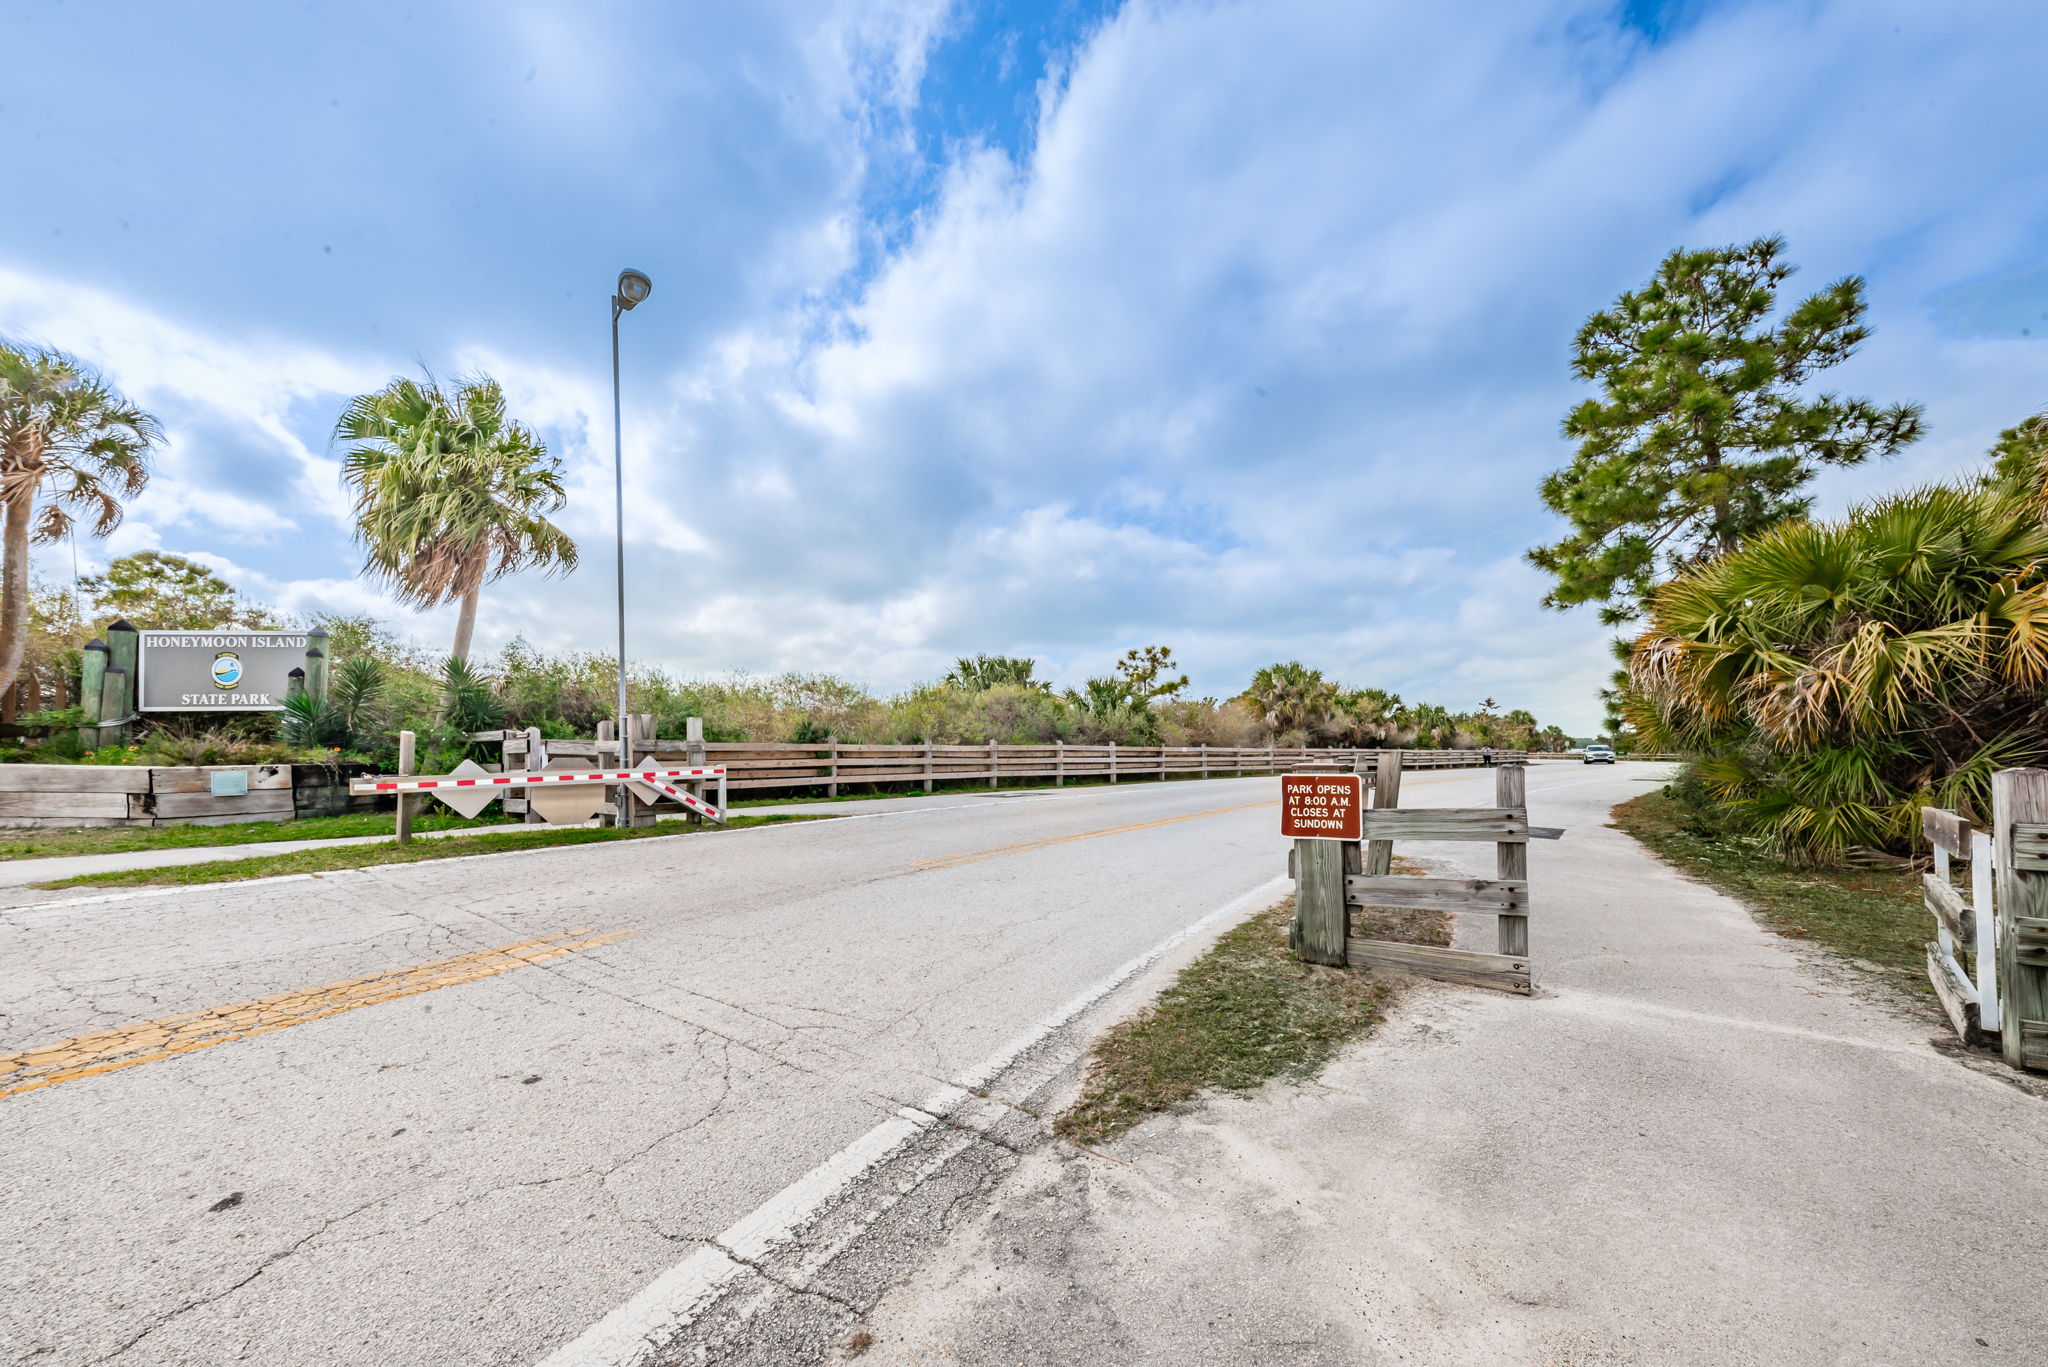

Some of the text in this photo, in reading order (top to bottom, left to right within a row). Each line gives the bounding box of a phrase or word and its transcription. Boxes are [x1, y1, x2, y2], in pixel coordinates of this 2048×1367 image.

[146, 636, 307, 648] HONEYMOON ISLAND
[181, 694, 270, 706] STATE PARK
[1287, 784, 1350, 794] PARK OPENS
[1288, 796, 1351, 806] AT 8:00 A.M.
[1290, 808, 1346, 818] CLOSES AT
[1294, 819, 1343, 829] SUNDOWN
